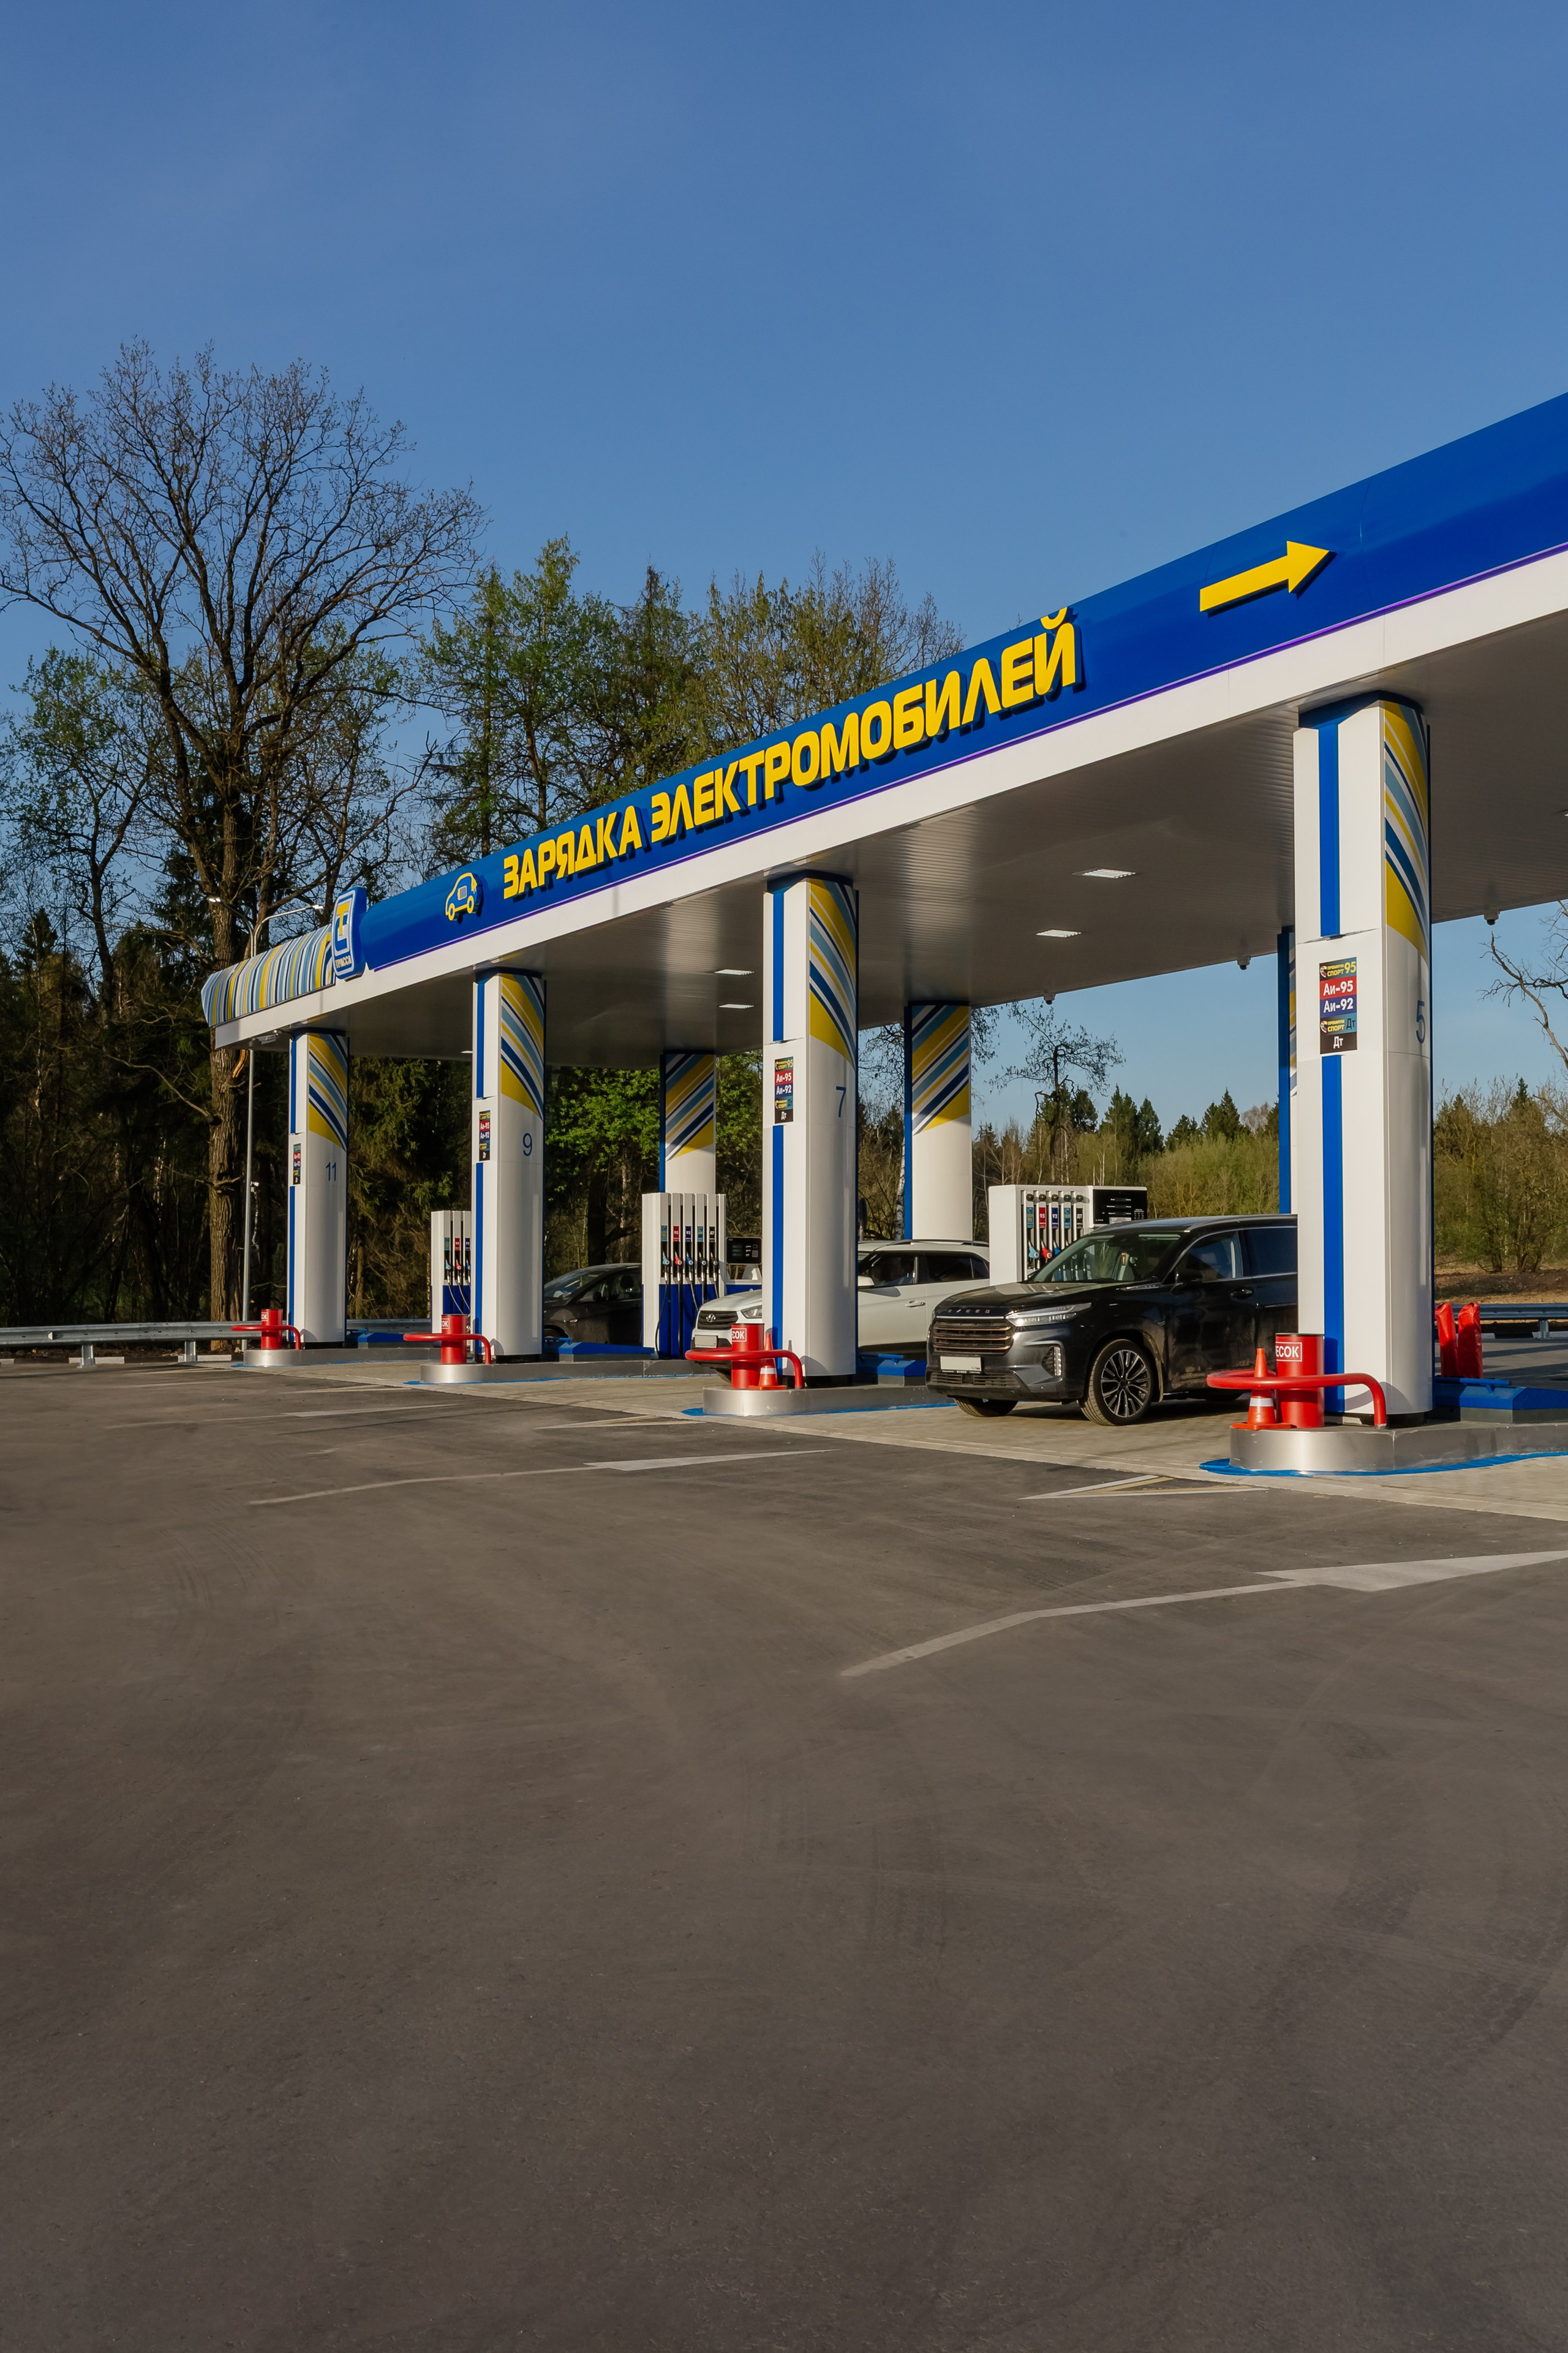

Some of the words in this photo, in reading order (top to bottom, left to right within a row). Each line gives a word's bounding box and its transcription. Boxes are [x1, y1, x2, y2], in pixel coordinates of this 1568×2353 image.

[504, 806, 642, 899] ЗАРЯДКА
[651, 608, 1076, 842] ЭЛЕКТРОМОБИЛЕЙ
[1344, 961, 1356, 973] 95
[1323, 980, 1354, 996] Аи-95
[1323, 997, 1354, 1013] Аи-92
[1416, 1000, 1426, 1044] 5
[1333, 1036, 1343, 1049] Дт
[776, 1073, 791, 1083] Аи-95
[776, 1085, 791, 1095] Аи-92
[835, 1086, 846, 1117] 7
[522, 1133, 532, 1157] 9
[325, 1161, 336, 1182] 11
[731, 1331, 745, 1339] СОК
